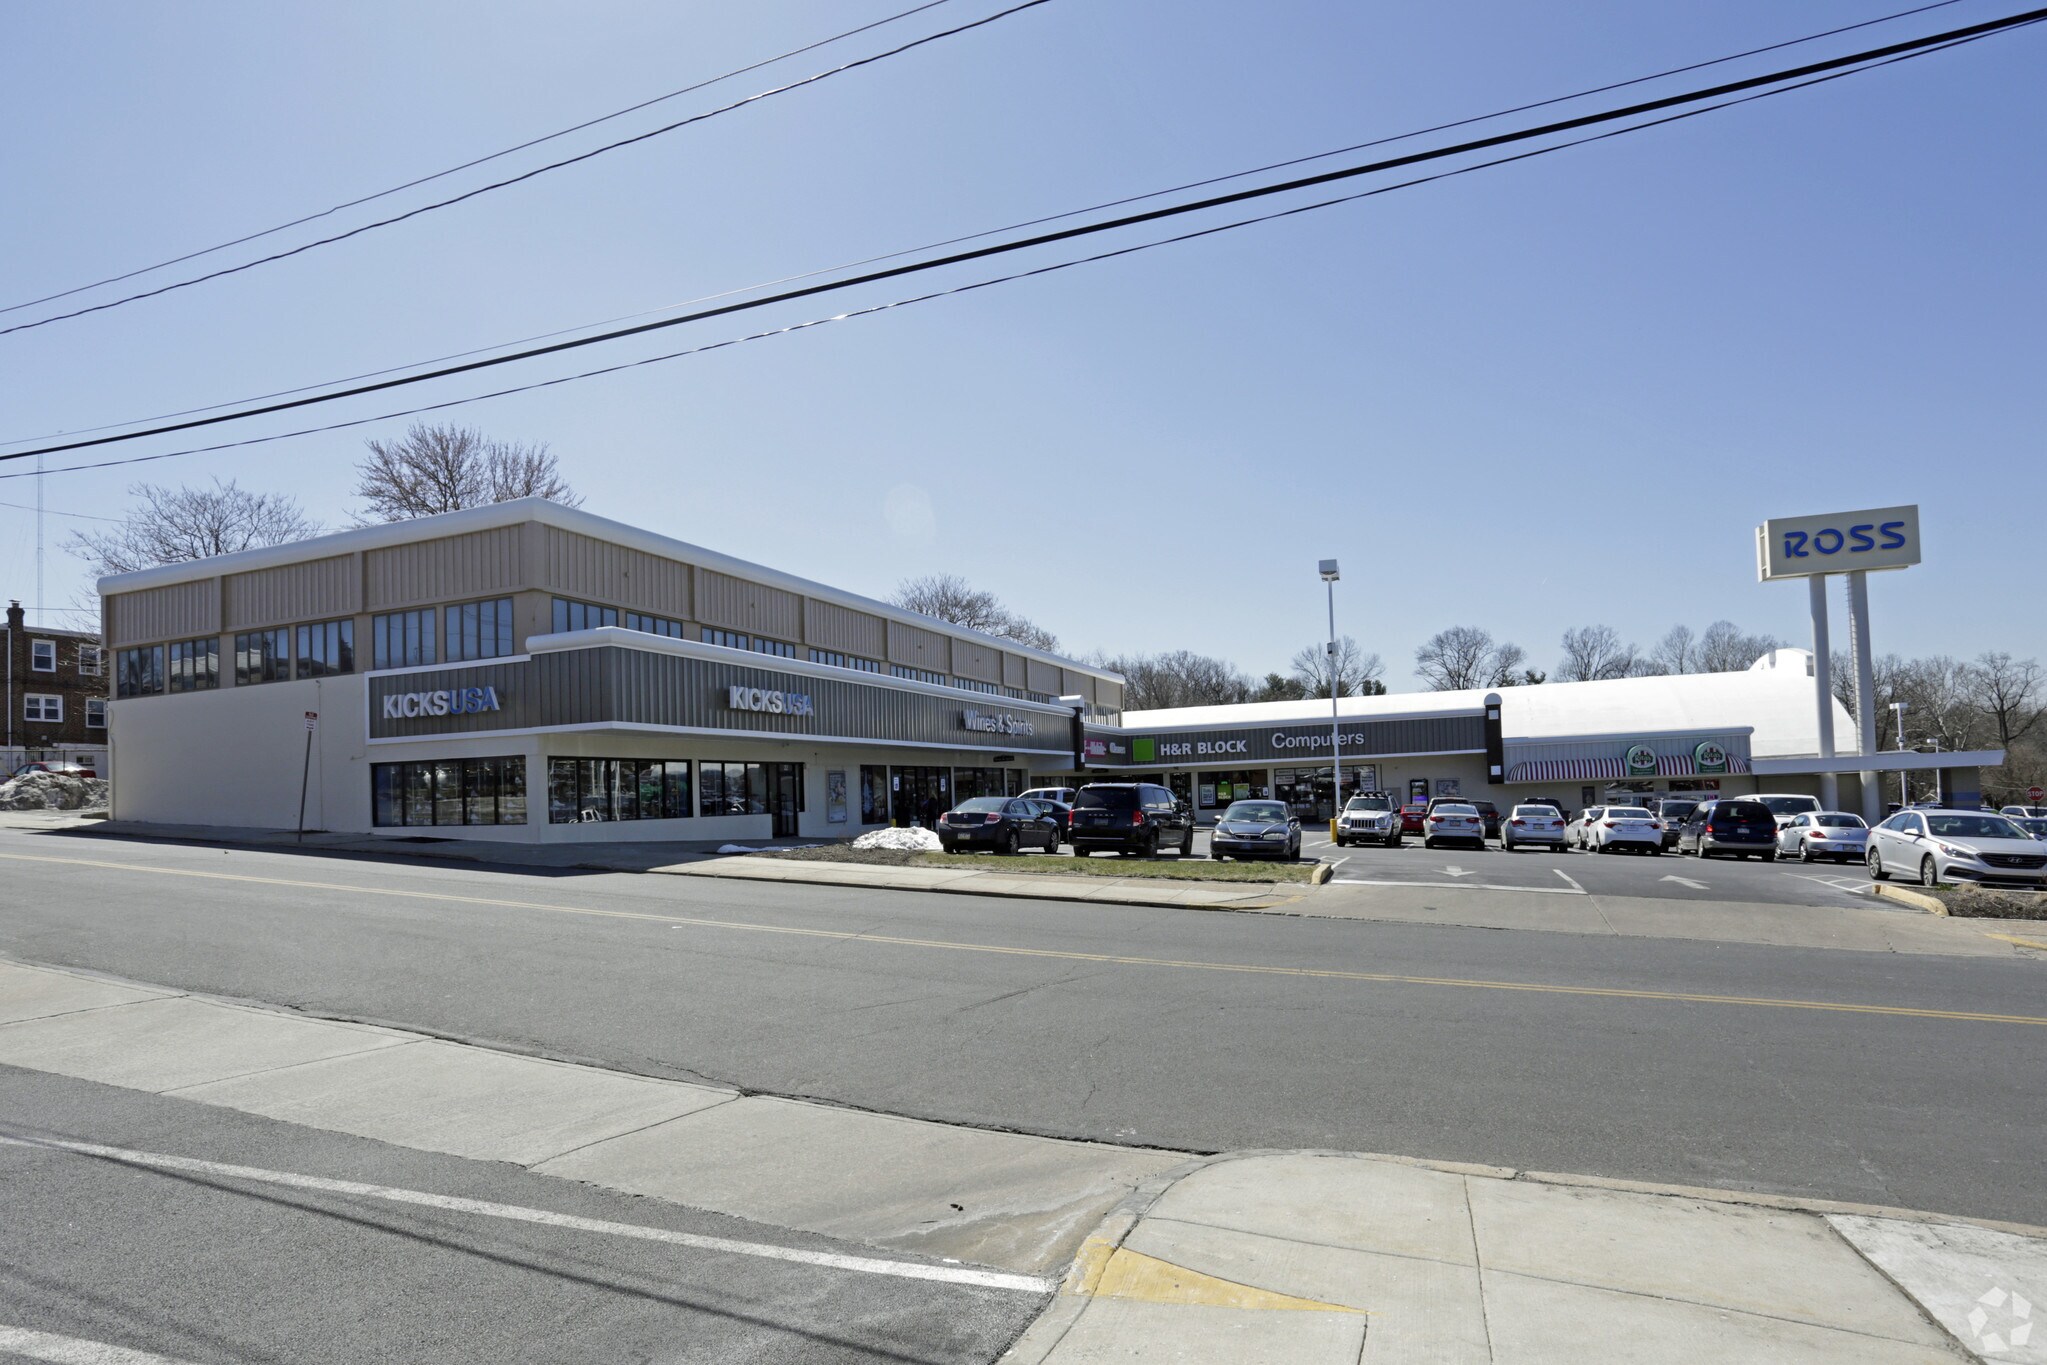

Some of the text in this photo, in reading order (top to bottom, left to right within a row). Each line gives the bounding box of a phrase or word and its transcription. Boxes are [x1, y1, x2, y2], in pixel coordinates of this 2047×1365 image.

[1784, 521, 1906, 558] ROSS
[963, 709, 1033, 737] Wines & Spirits
[1160, 740, 1247, 756] H&R BLOCK
